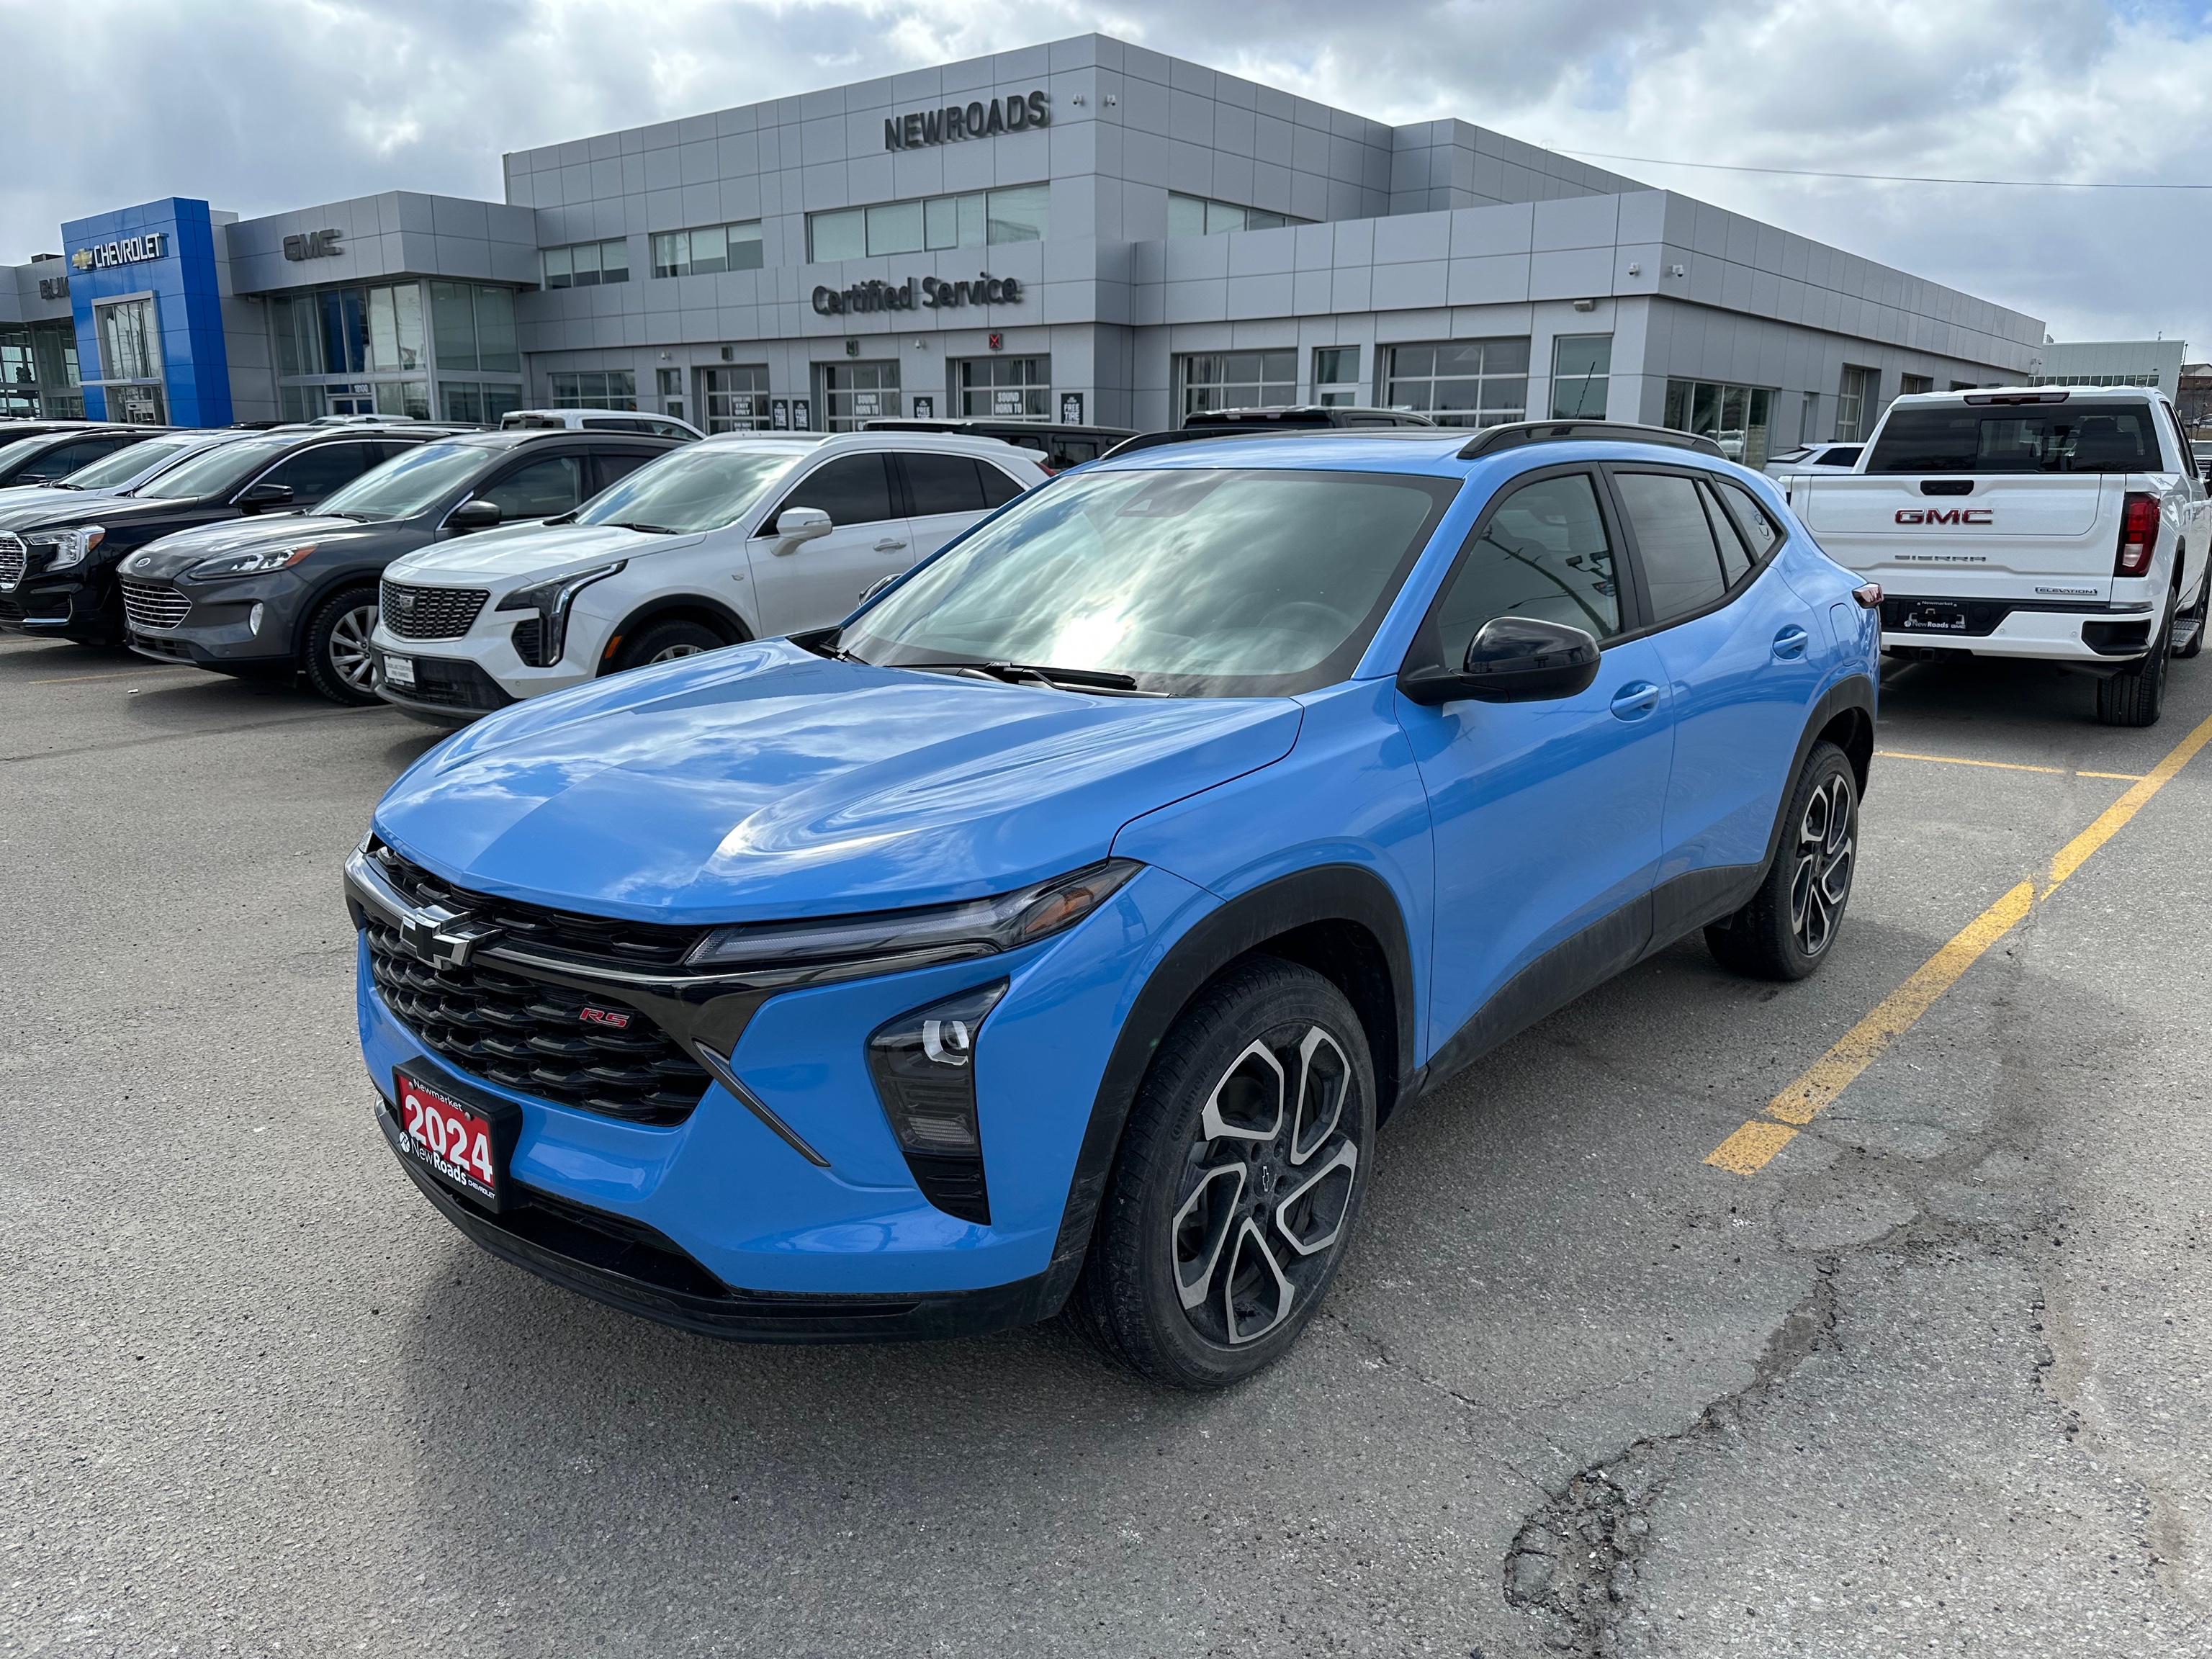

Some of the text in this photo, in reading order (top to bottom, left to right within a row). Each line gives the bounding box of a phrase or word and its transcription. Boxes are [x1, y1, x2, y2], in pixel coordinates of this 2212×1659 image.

[885, 91, 1051, 150] NEWROADS
[94, 233, 162, 267] CHEVROLET
[283, 229, 342, 261] GMC
[39, 276, 71, 300] BUIC
[812, 271, 1022, 315] Certified Service
[858, 395, 876, 404] SOUND
[997, 392, 1020, 403] SOUND
[1064, 403, 1080, 412] FREE
[855, 405, 879, 415] HORN TO
[995, 403, 1022, 414] HORN TO
[1894, 508, 1994, 525] GMC
[580, 1007, 629, 1028] RS
[413, 1079, 463, 1112] Newmarket
[405, 1094, 493, 1183] 2024
[468, 1179, 495, 1199] CHEVROLET
